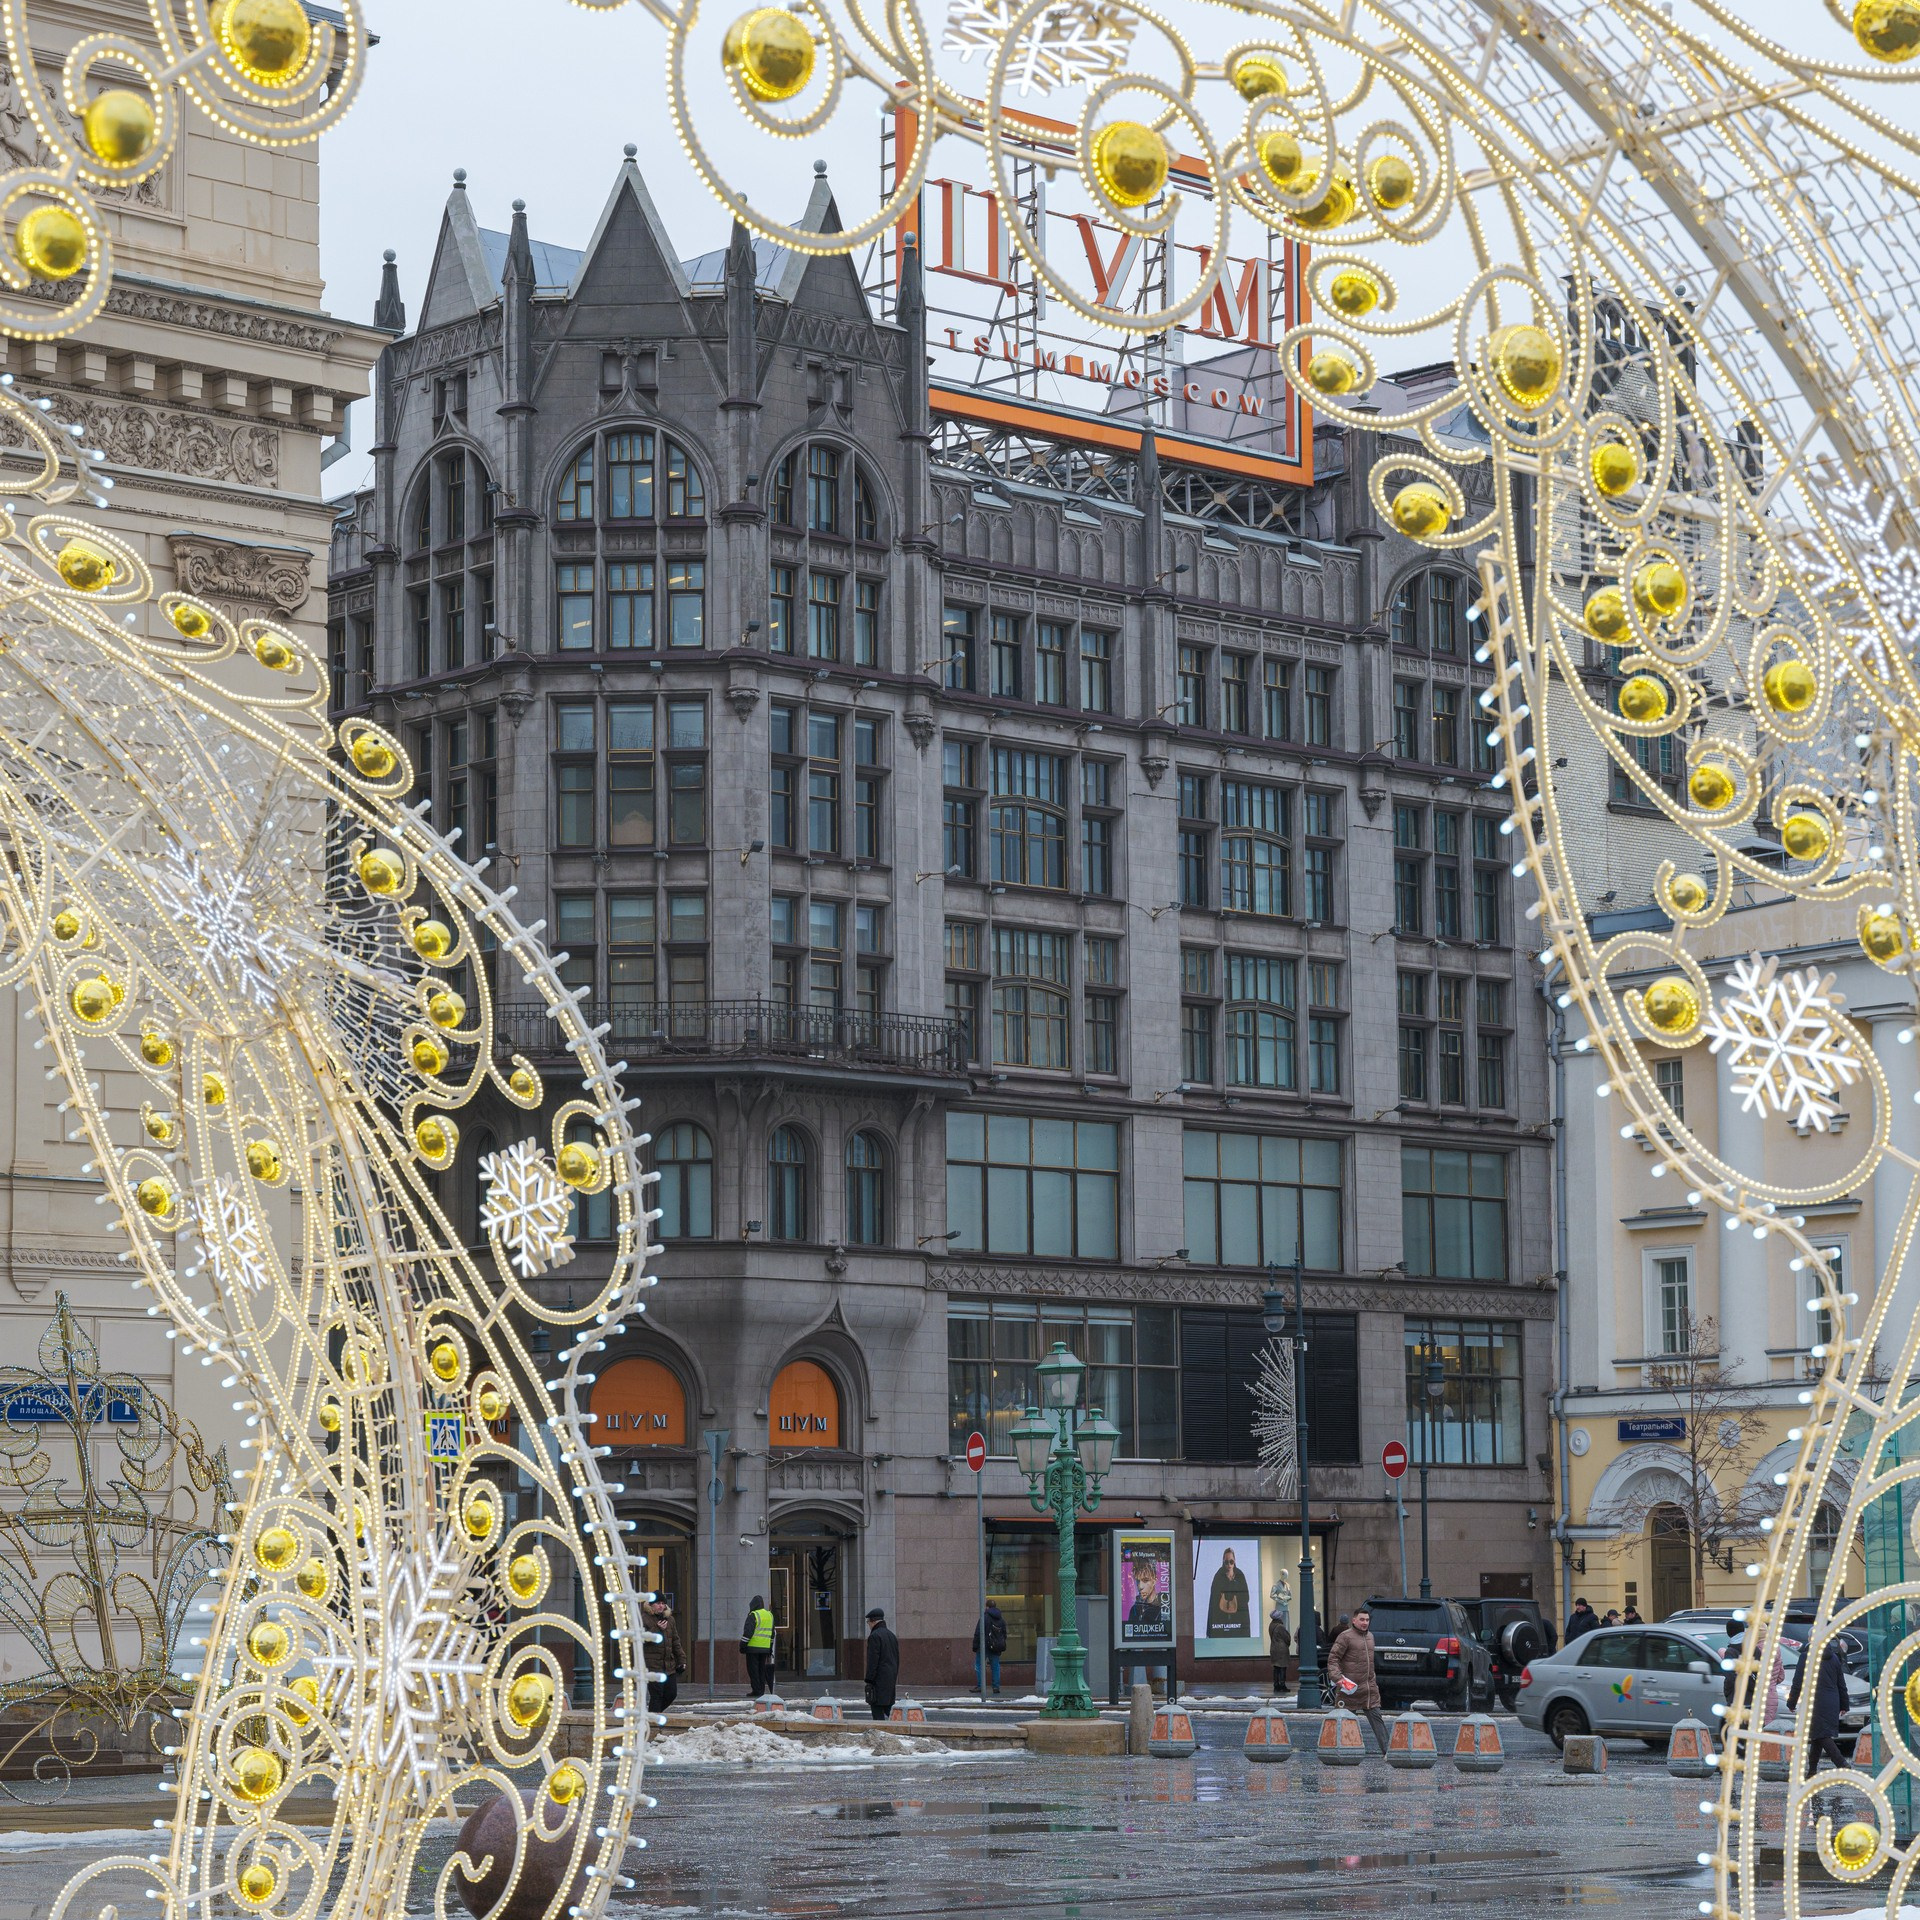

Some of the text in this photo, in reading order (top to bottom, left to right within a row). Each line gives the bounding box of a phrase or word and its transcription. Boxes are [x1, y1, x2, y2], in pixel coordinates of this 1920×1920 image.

[943, 327, 1266, 416] TSUM MOSCOW
[20, 1407, 59, 1415] ПЛОЩАД
[1628, 1422, 1674, 1432] Театральная
[1160, 1561, 1170, 1615] EXCLUSIVE
[1133, 1622, 1165, 1634] ЭЛДЖЕЙ
